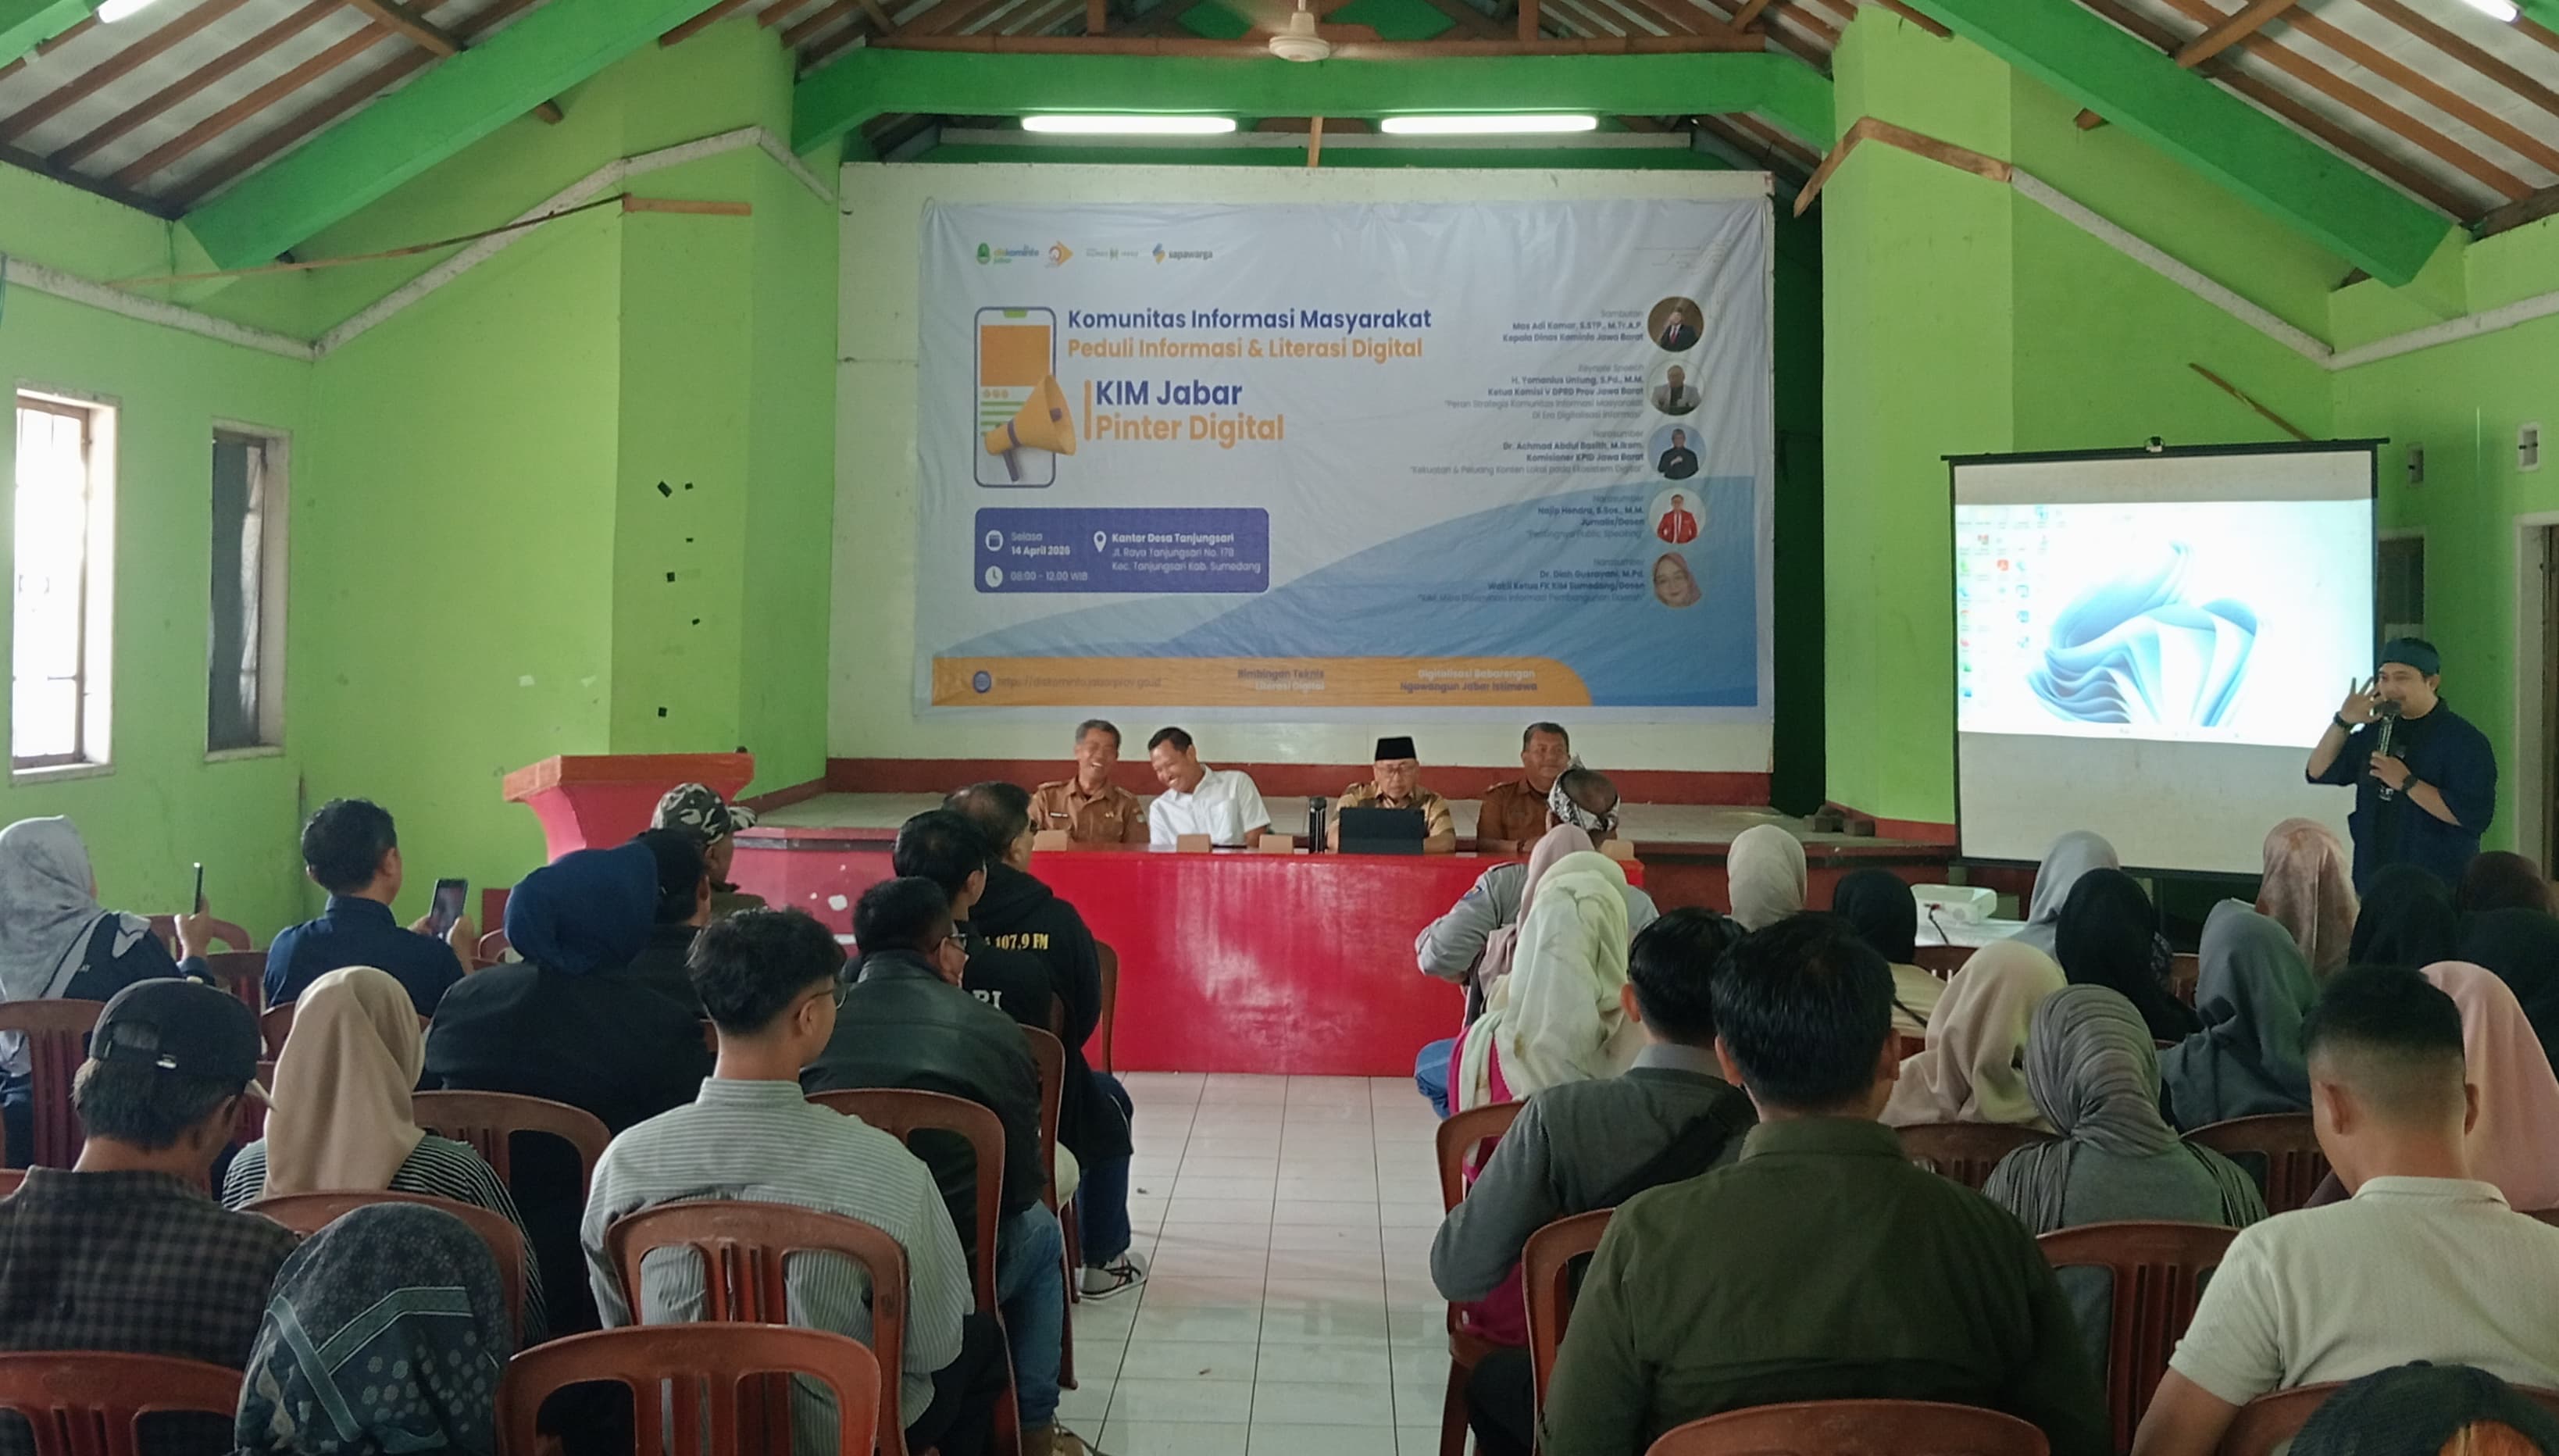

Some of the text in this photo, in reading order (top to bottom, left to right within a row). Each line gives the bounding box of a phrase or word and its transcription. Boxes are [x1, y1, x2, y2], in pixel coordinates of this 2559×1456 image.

[1169, 252, 1212, 261] sapawarga
[1069, 308, 1431, 334] Komunitas Informasi Masyarakat
[1532, 321, 1546, 330] Adi
[1503, 334, 1533, 344] Kepala
[1534, 334, 1558, 342] Dinas
[1620, 334, 1644, 342] Barat
[1068, 337, 1422, 364] Peduli Informasi & Literasi Digital
[1522, 376, 1563, 384] Yomanius
[1565, 376, 1597, 386] Untung,
[1096, 380, 1242, 405] KIM Jabar
[1515, 387, 1543, 396] Komisi
[1621, 387, 1644, 396] Barat
[1472, 400, 1508, 410] Strategis
[1556, 399, 1594, 408] Informasi
[1557, 411, 1601, 420] Digitalisasi
[1096, 413, 1284, 449] Pinter Digital
[1593, 430, 1644, 438] Narasumber
[1554, 441, 1579, 450] Abdul
[1526, 453, 1574, 462] Komisioner
[1597, 453, 1619, 462] Jawa
[1621, 453, 1644, 462] Barat
[1538, 506, 1560, 517] Najip
[1011, 532, 1043, 541] Selasa
[1112, 533, 1234, 546] Kantor Desa Tanjungsari
[1012, 546, 1021, 556] 14
[1023, 545, 1046, 559] April
[1112, 547, 1122, 557] Jl.
[1123, 548, 1147, 559] Raya
[1148, 547, 1202, 560] Tanjungsari
[1204, 548, 1218, 557] No.
[1112, 562, 1261, 574] Kec. Tanjungsari Kab. Sumedang
[1070, 571, 1088, 581] WIB
[1419, 669, 1535, 680] Digitalisasi Babarengan
[995, 933, 1030, 950] 107.9
[1033, 933, 1048, 950] FM
